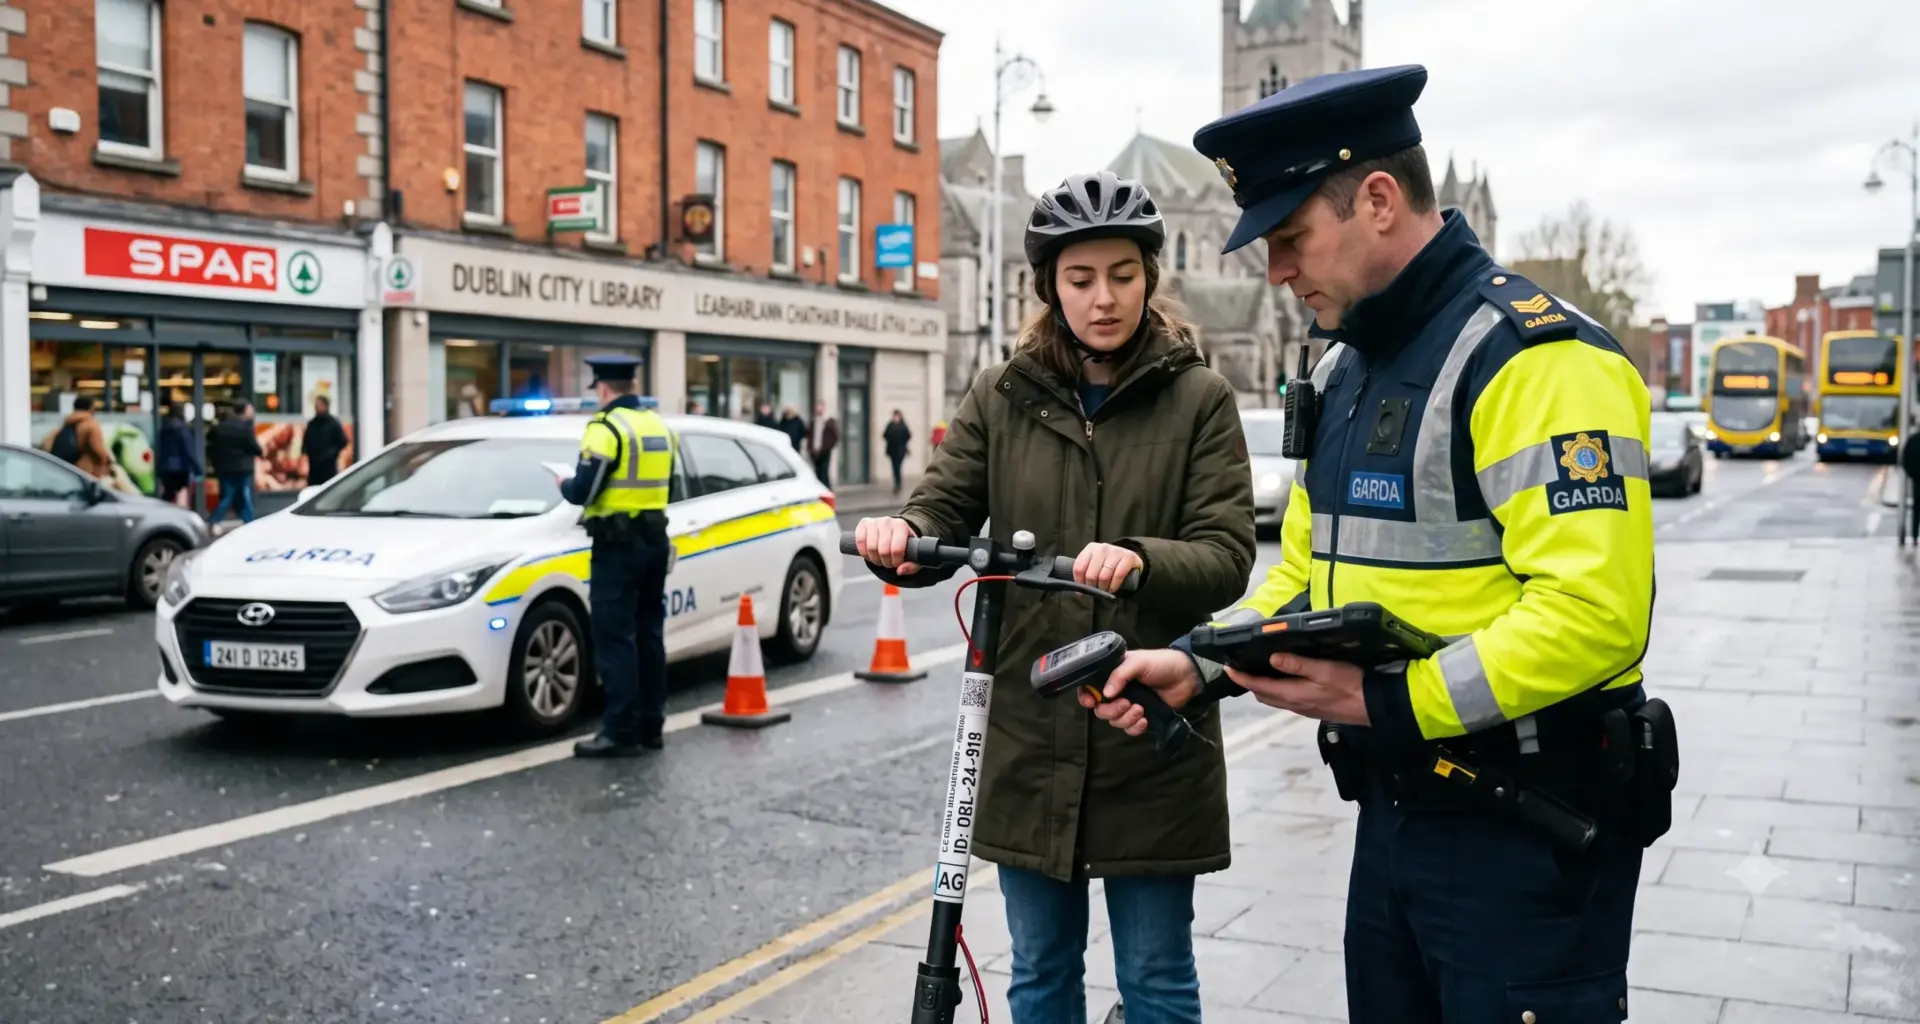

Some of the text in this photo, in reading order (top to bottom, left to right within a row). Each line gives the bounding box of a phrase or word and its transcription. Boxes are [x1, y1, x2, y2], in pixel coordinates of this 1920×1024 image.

[129, 239, 275, 285] SPAR
[453, 264, 664, 311] DUBLIN CITY LIBRARY
[1525, 313, 1567, 328] GARDA
[1352, 477, 1401, 502] GARDA
[1553, 486, 1625, 509] GARDA
[244, 547, 376, 567] GARDA
[216, 646, 298, 667] 241 D 12345
[953, 833, 969, 854] ID:
[938, 872, 964, 891] AG
